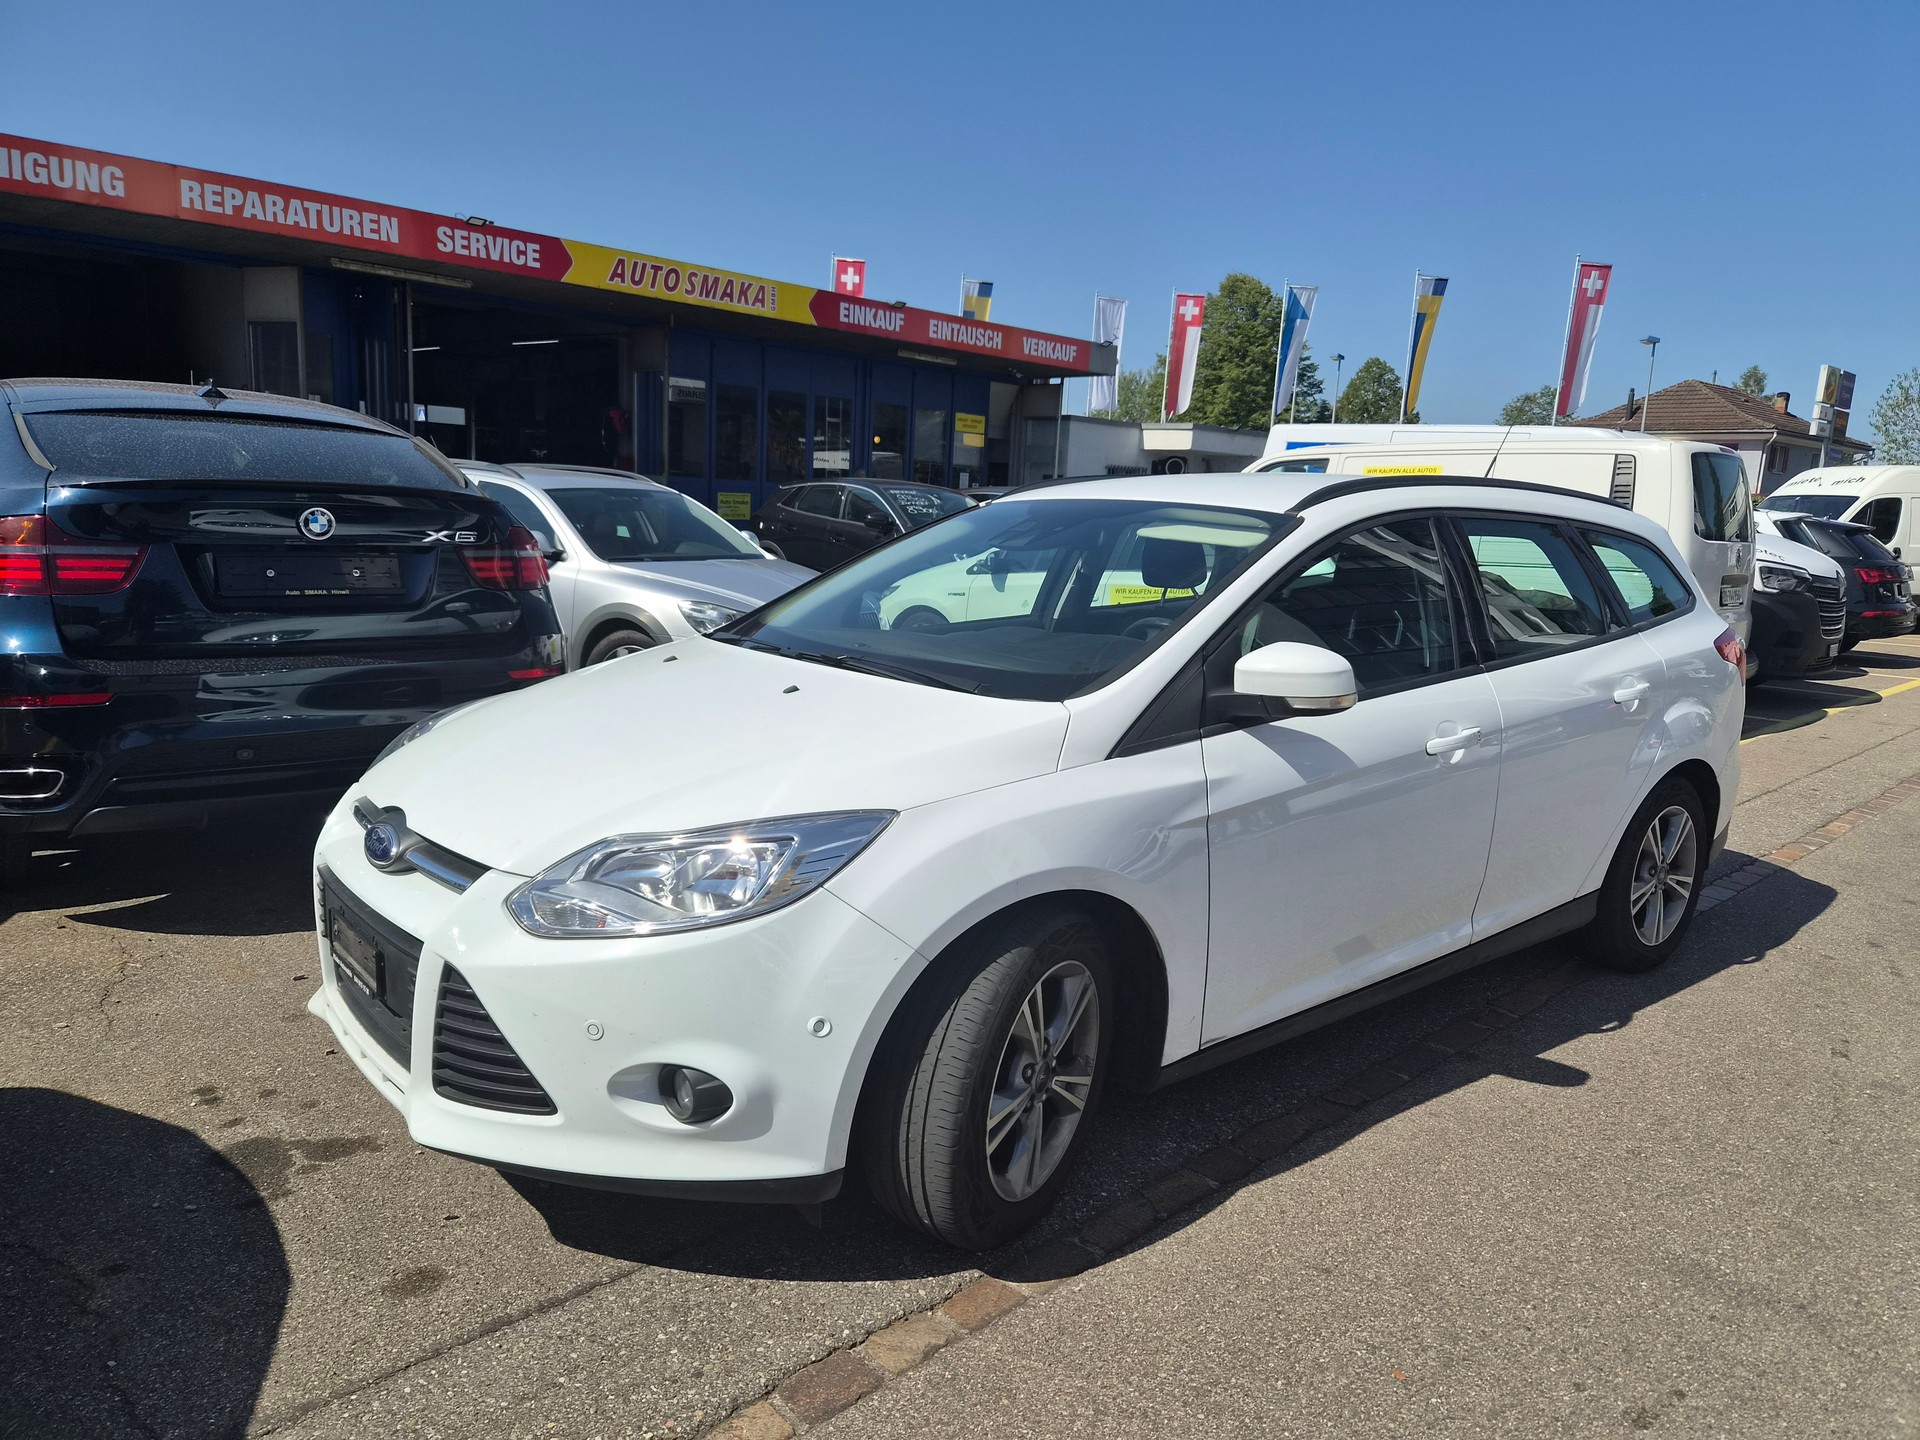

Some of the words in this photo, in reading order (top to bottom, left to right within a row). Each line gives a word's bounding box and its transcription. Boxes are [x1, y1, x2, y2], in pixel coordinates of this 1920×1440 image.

[180, 179, 400, 244] REPARATUREN
[436, 226, 541, 269] SERVICE
[608, 256, 682, 293] AUTO
[684, 270, 767, 309] SMAKA
[769, 285, 778, 312] GMBH
[839, 302, 904, 332] EINKAUF
[928, 319, 1002, 350] EINTAUSCH
[1022, 336, 1078, 362] VERKAUF
[1831, 476, 1866, 486] mich
[421, 530, 478, 542] X6
